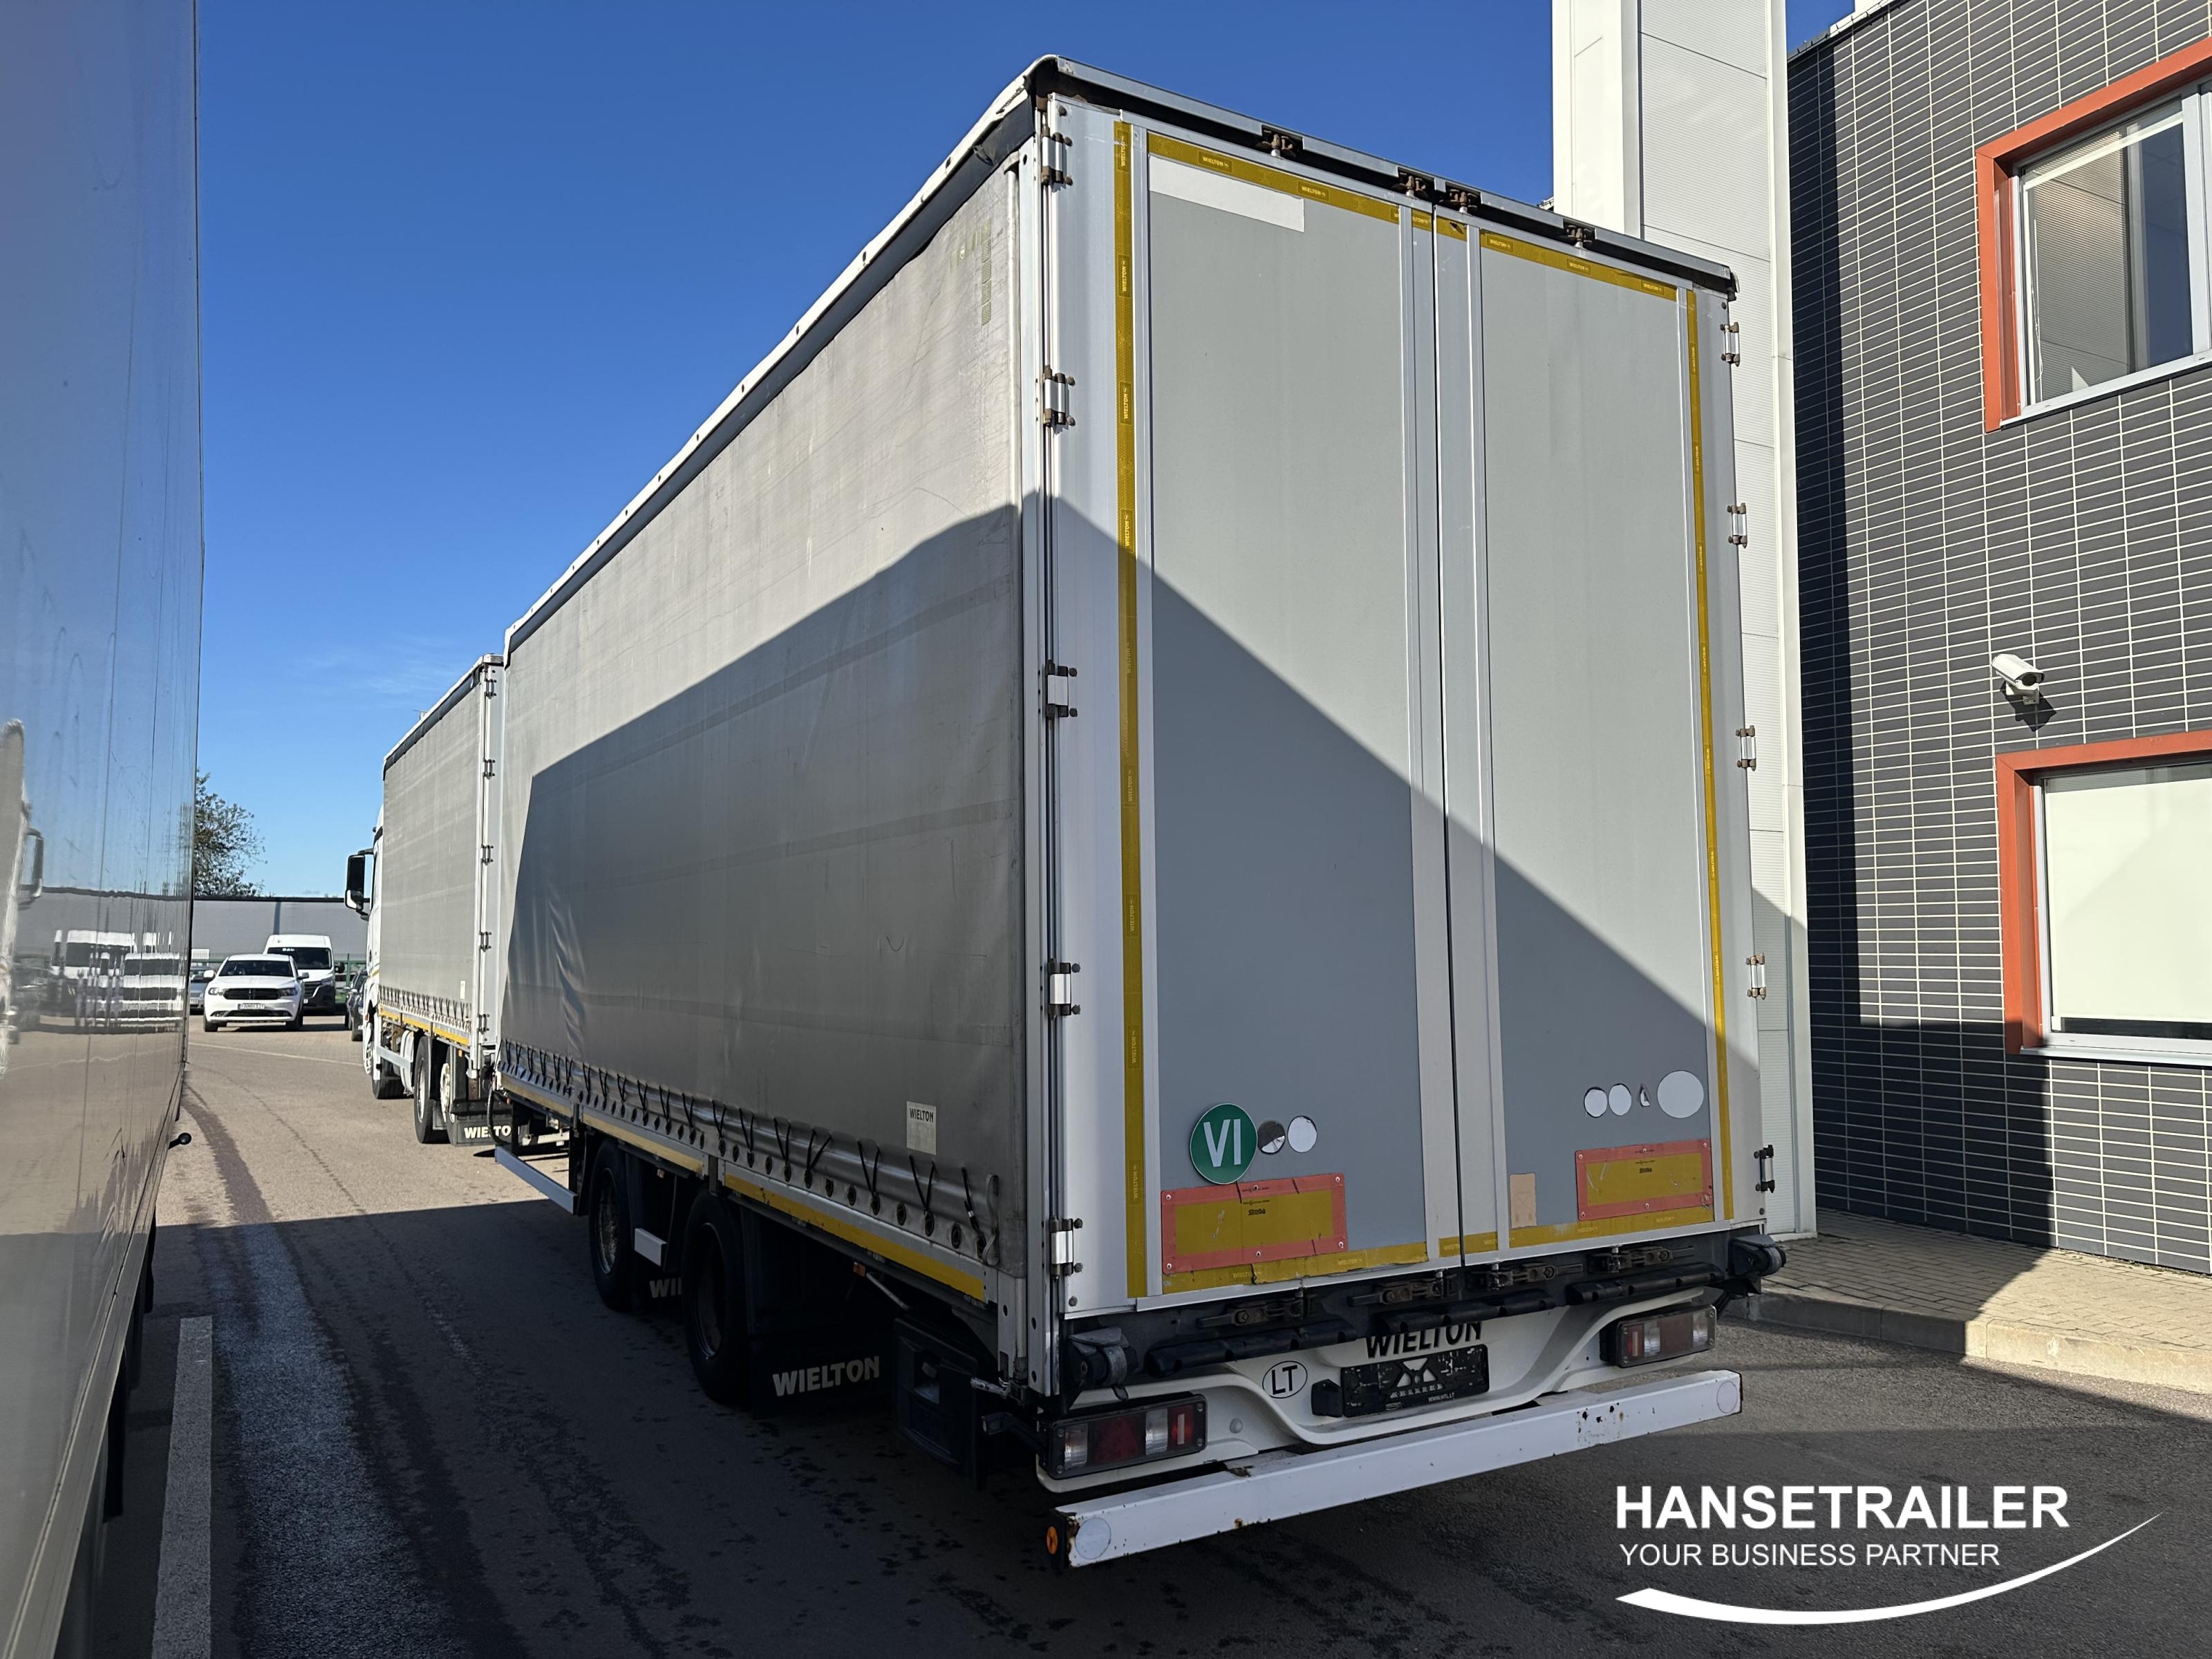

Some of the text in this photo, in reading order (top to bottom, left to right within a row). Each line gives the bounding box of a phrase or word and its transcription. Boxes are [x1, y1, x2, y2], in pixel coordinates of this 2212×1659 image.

[1202, 156, 1224, 167] WIELTON
[909, 1107, 934, 1123] WIELTON
[1203, 1118, 1242, 1168] VI
[1366, 1321, 1482, 1358] WIELTON
[772, 1356, 880, 1397] WIELTON
[1271, 1365, 1297, 1395] LT
